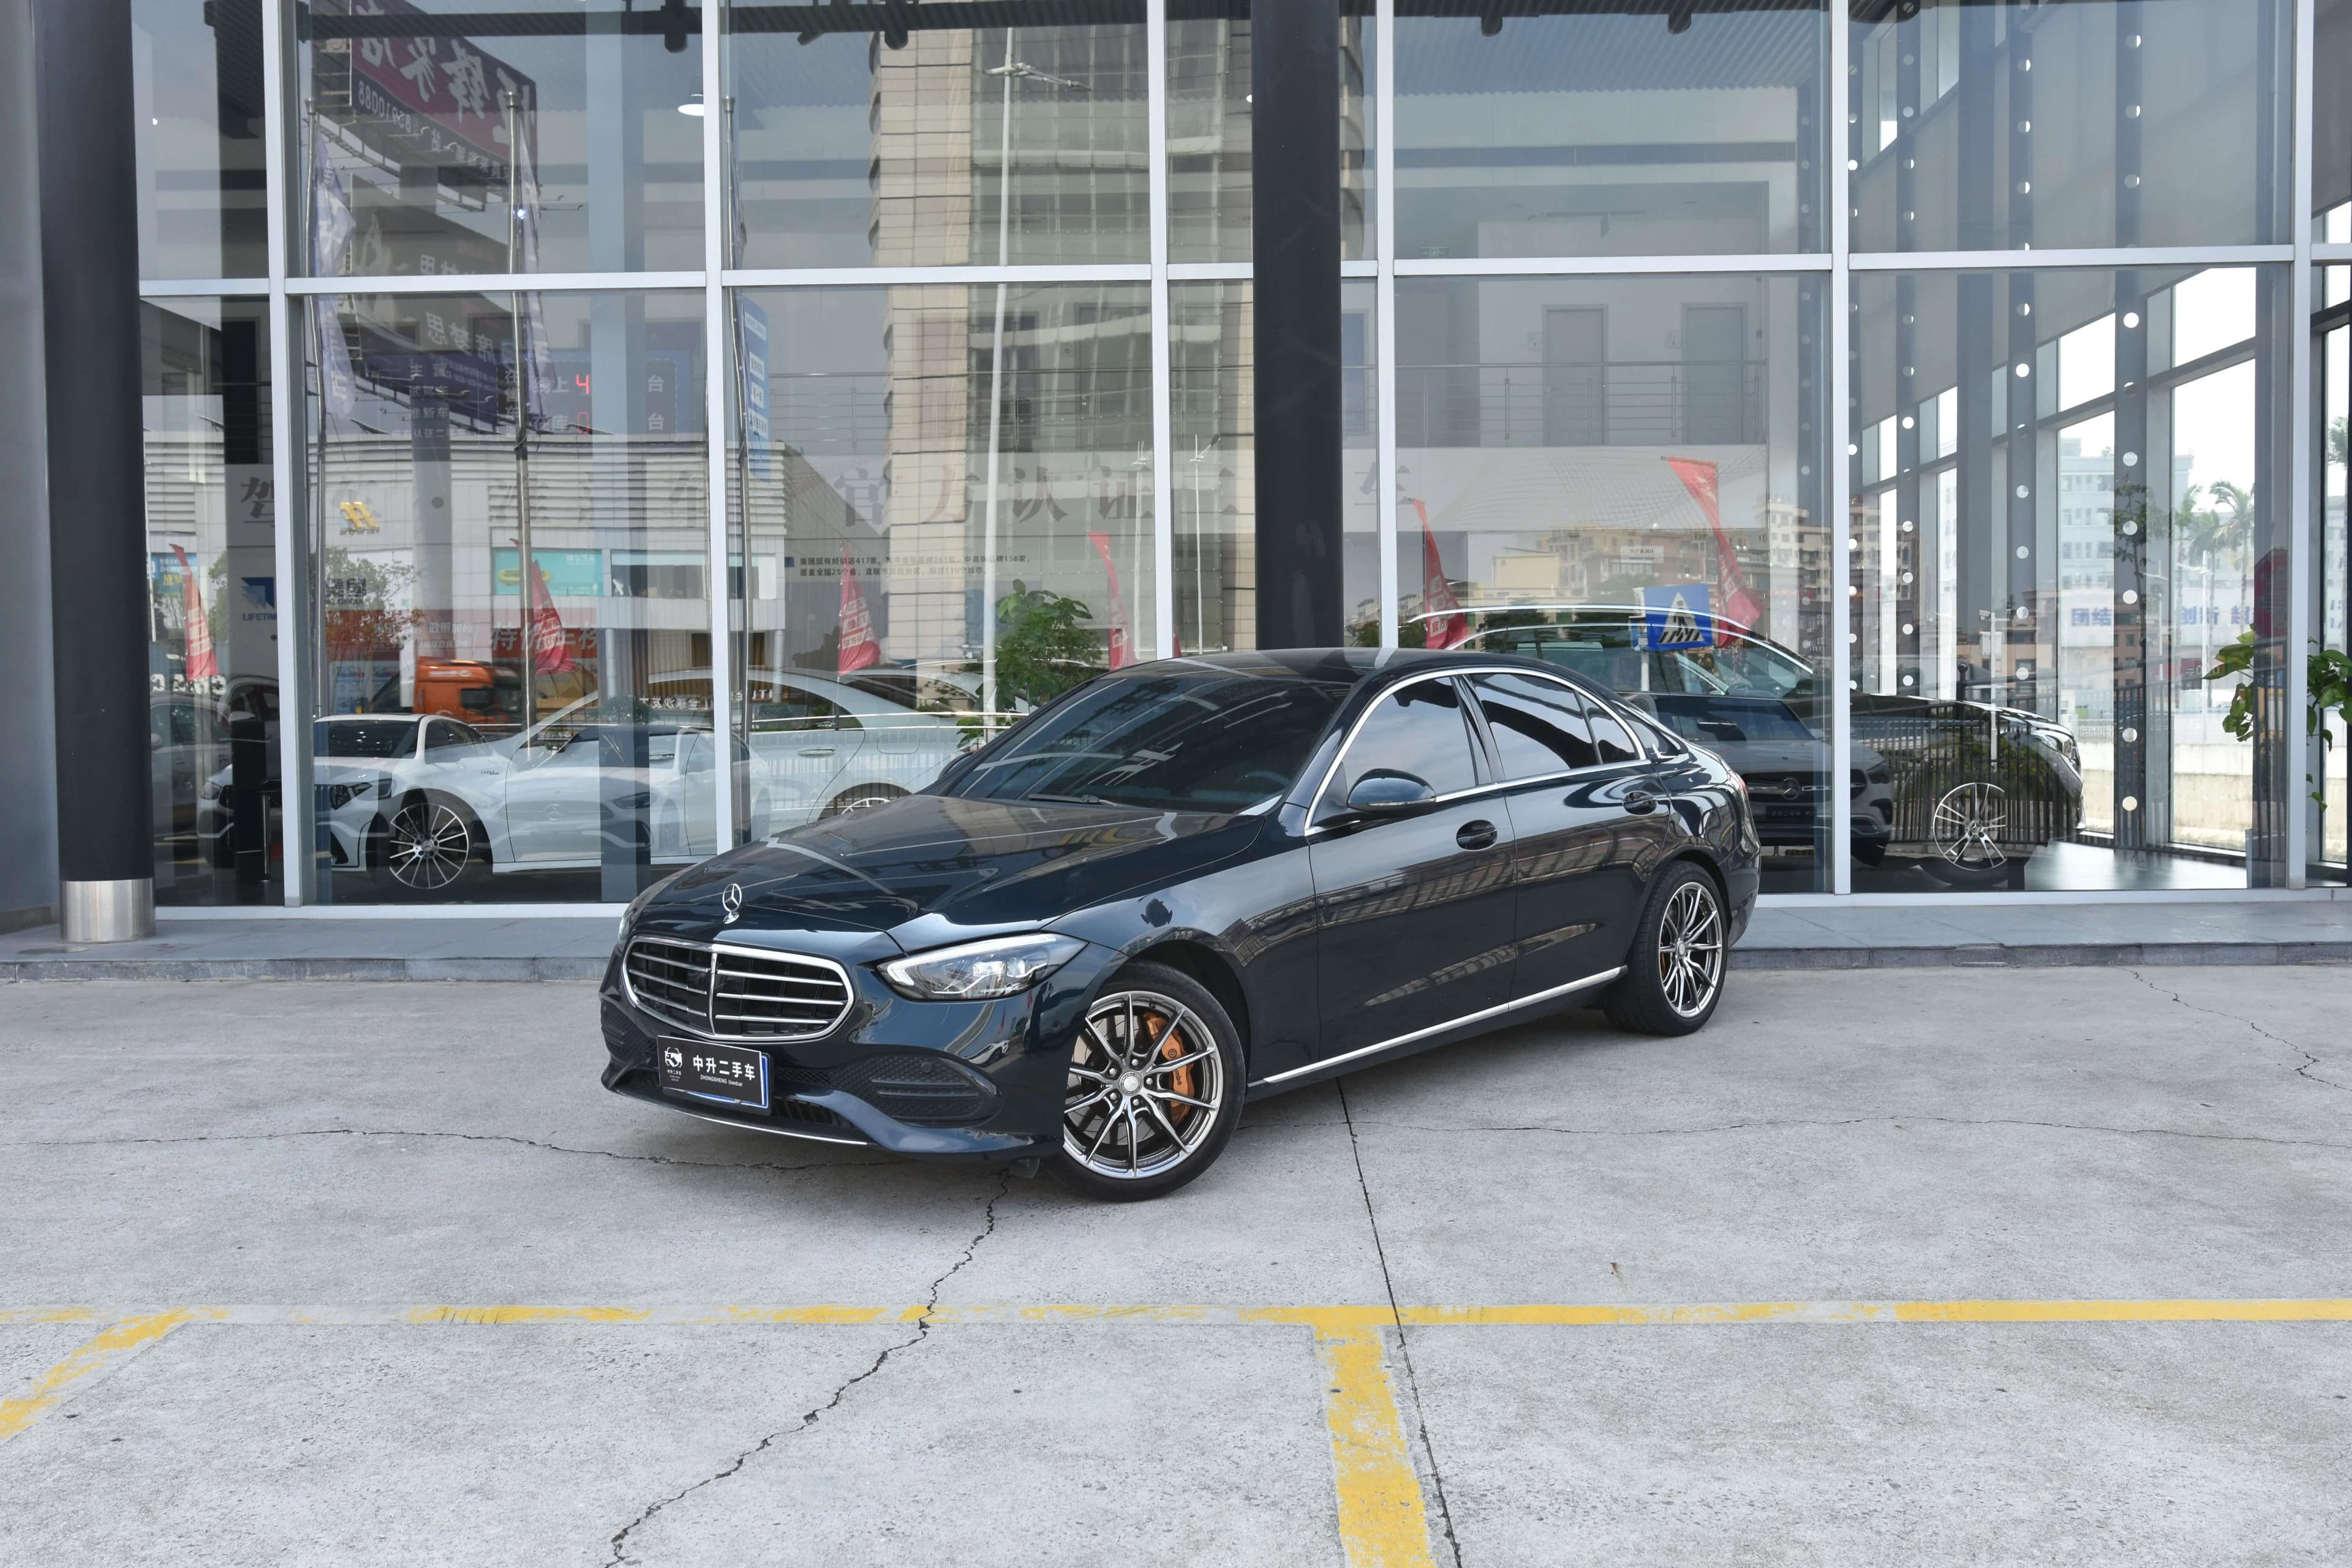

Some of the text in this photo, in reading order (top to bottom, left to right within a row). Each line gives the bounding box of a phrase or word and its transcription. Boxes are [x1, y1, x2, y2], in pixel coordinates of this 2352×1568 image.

[576, 374, 590, 395] 4
[646, 374, 665, 393] 台
[647, 412, 666, 432] 台
[693, 1055, 755, 1080] 中升二手车
[700, 1074, 744, 1087] ZHONGSHENG Usedcar
